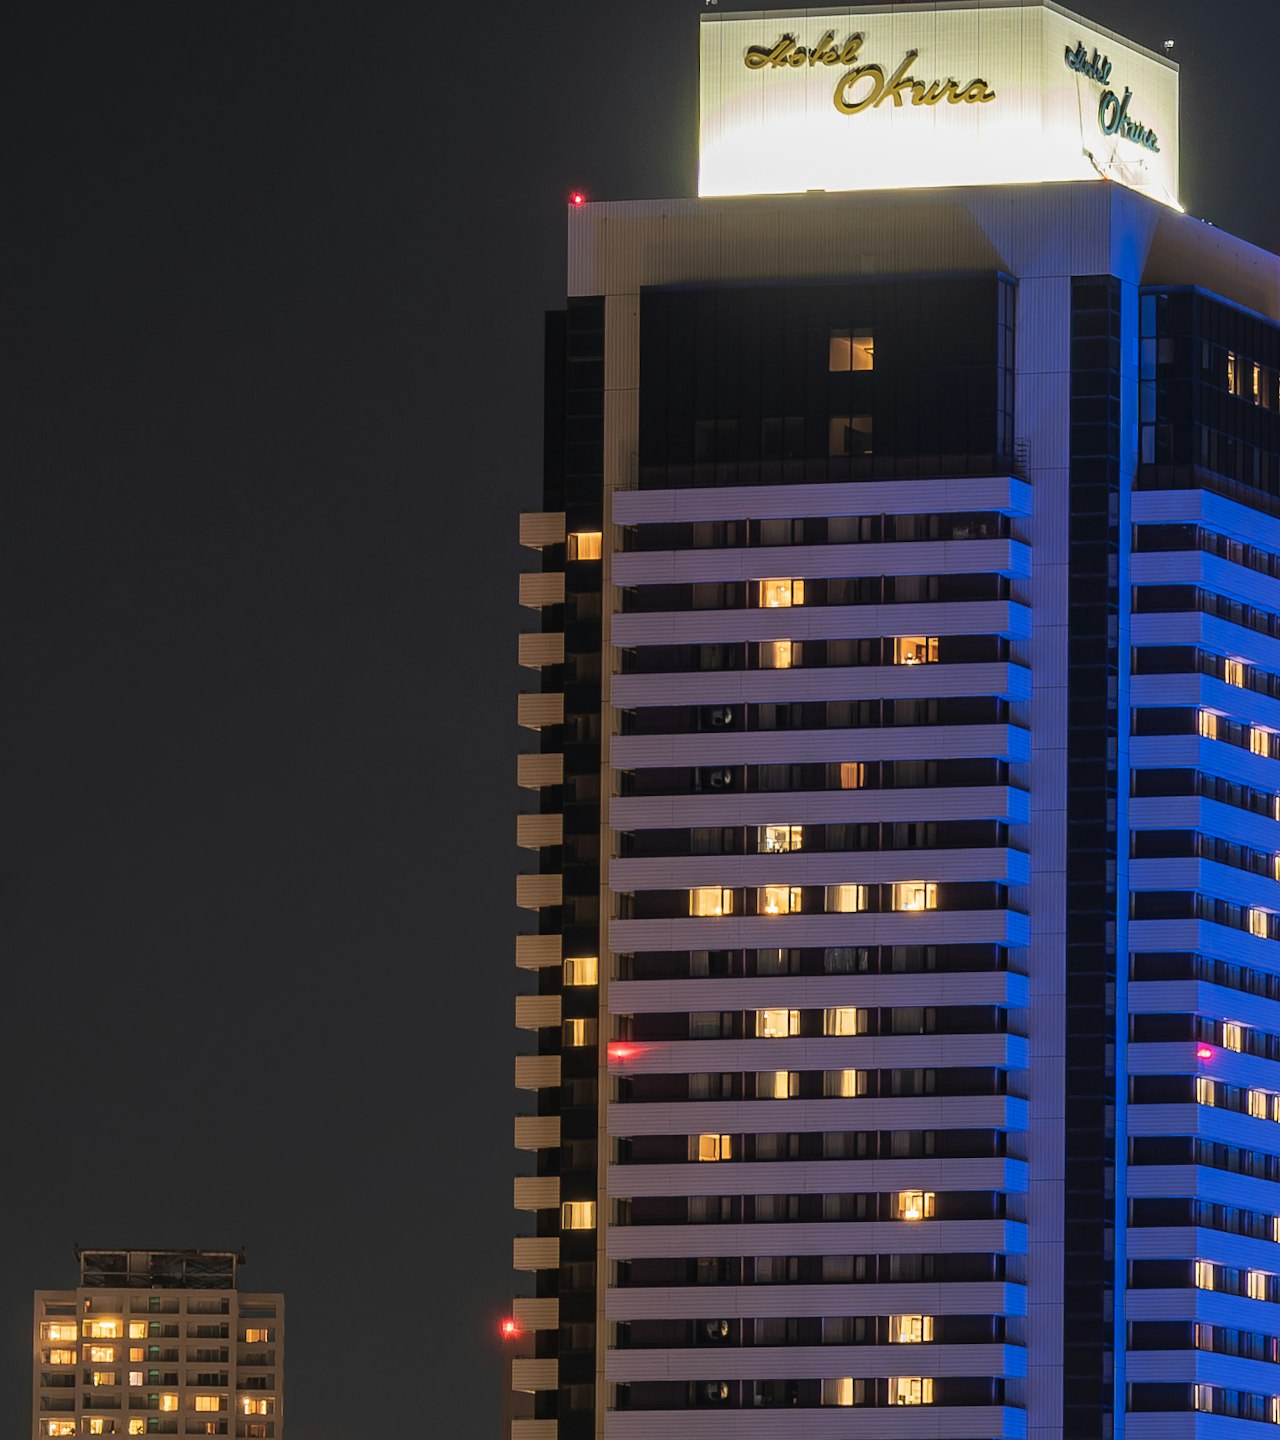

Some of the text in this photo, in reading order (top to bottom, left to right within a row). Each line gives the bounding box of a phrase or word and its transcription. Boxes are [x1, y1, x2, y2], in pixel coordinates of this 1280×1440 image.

[745, 30, 865, 70] Hotel
[1065, 40, 1112, 86] Hotel
[833, 50, 996, 117] Okura
[1099, 86, 1160, 153] Okura
